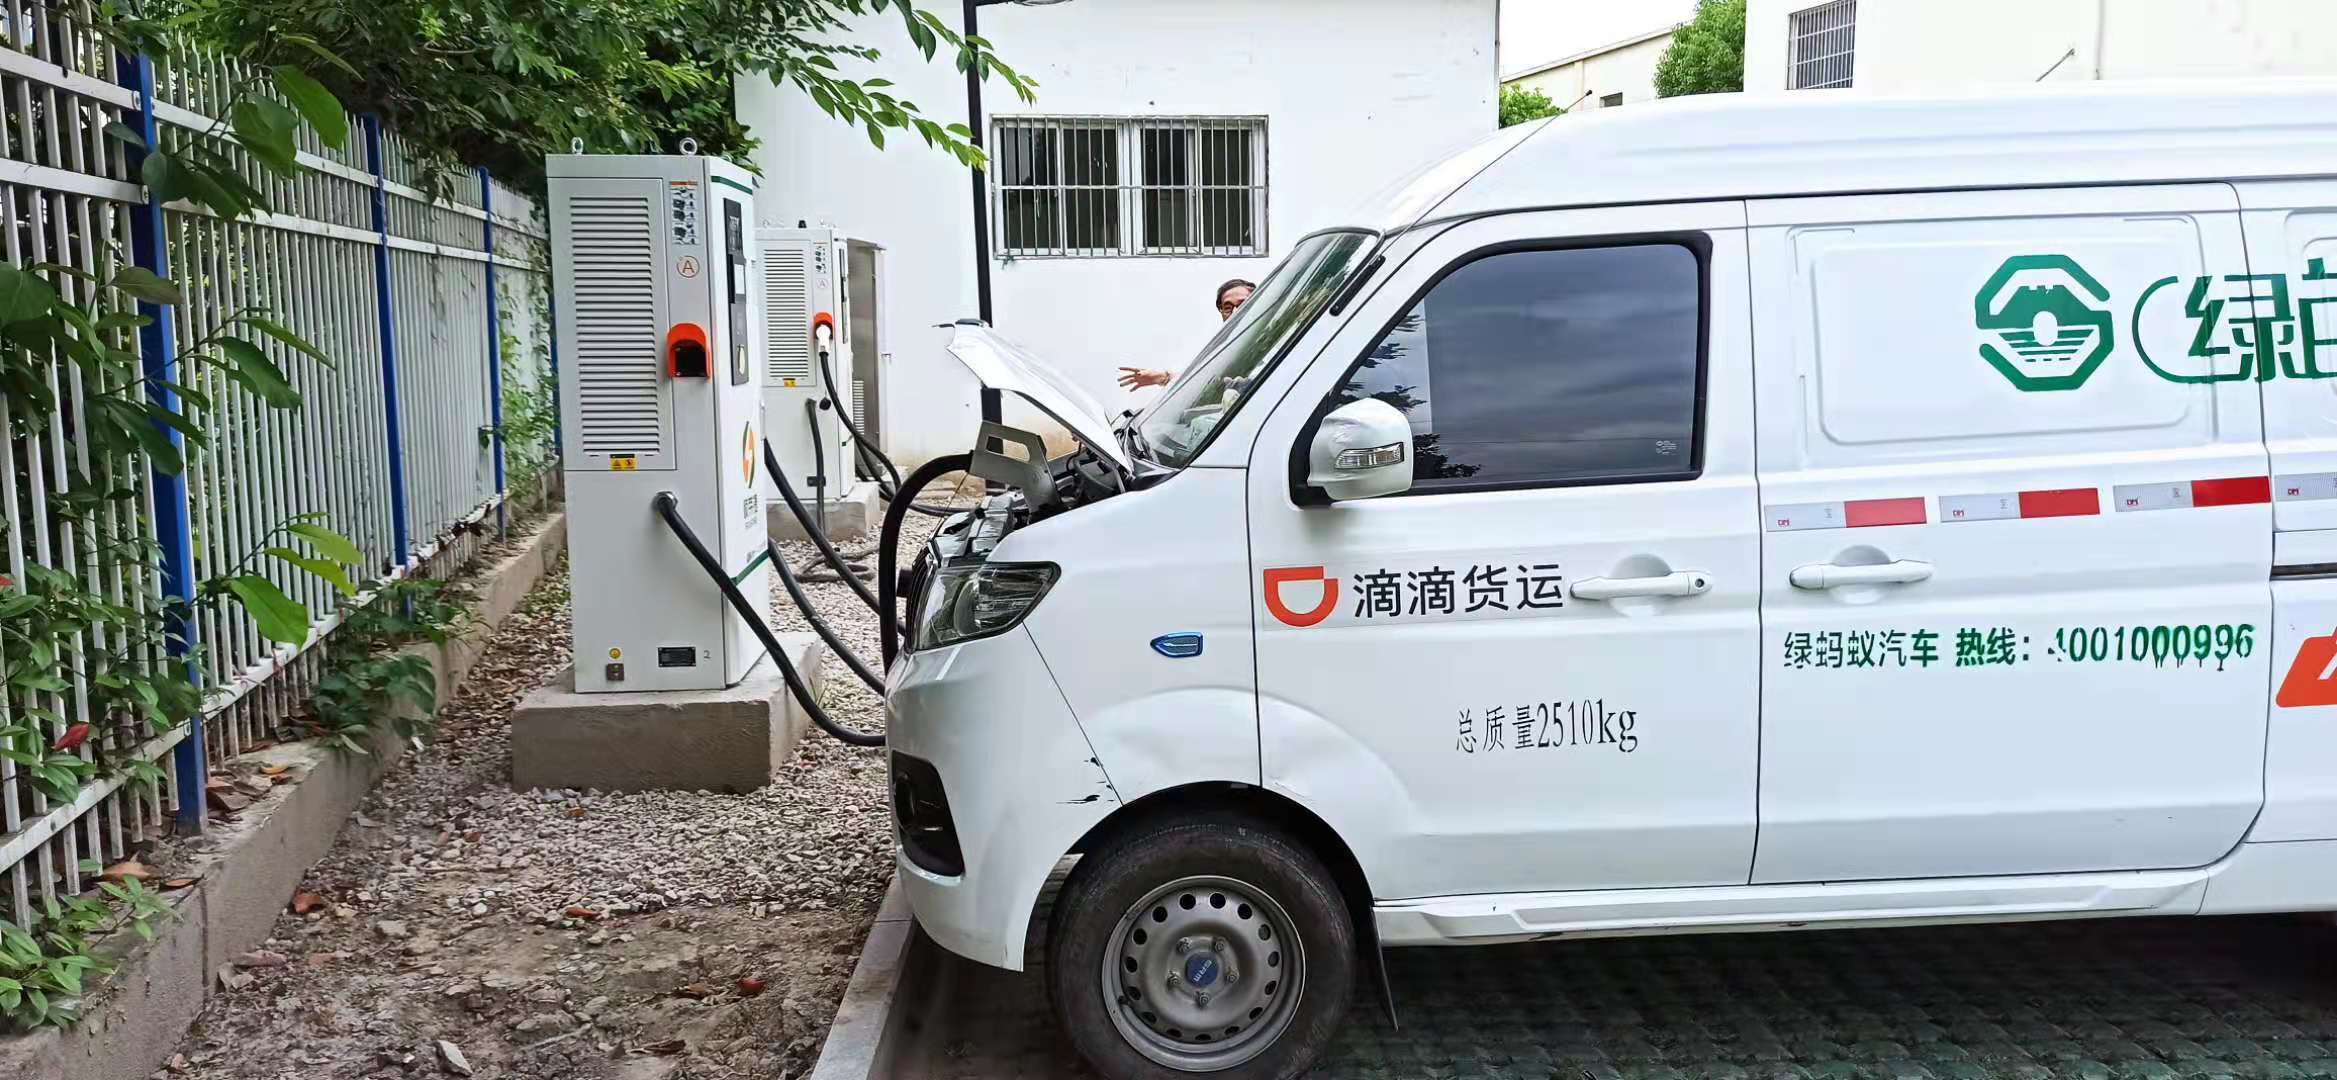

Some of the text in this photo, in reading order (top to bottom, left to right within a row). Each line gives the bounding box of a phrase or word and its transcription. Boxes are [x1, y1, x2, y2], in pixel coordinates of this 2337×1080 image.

[682, 260, 695, 273] A
[1353, 564, 1563, 618] 滴滴货运
[1784, 629, 1938, 669] 绿蚂蚁汽车
[1456, 698, 1638, 752] 总质量2510kg
